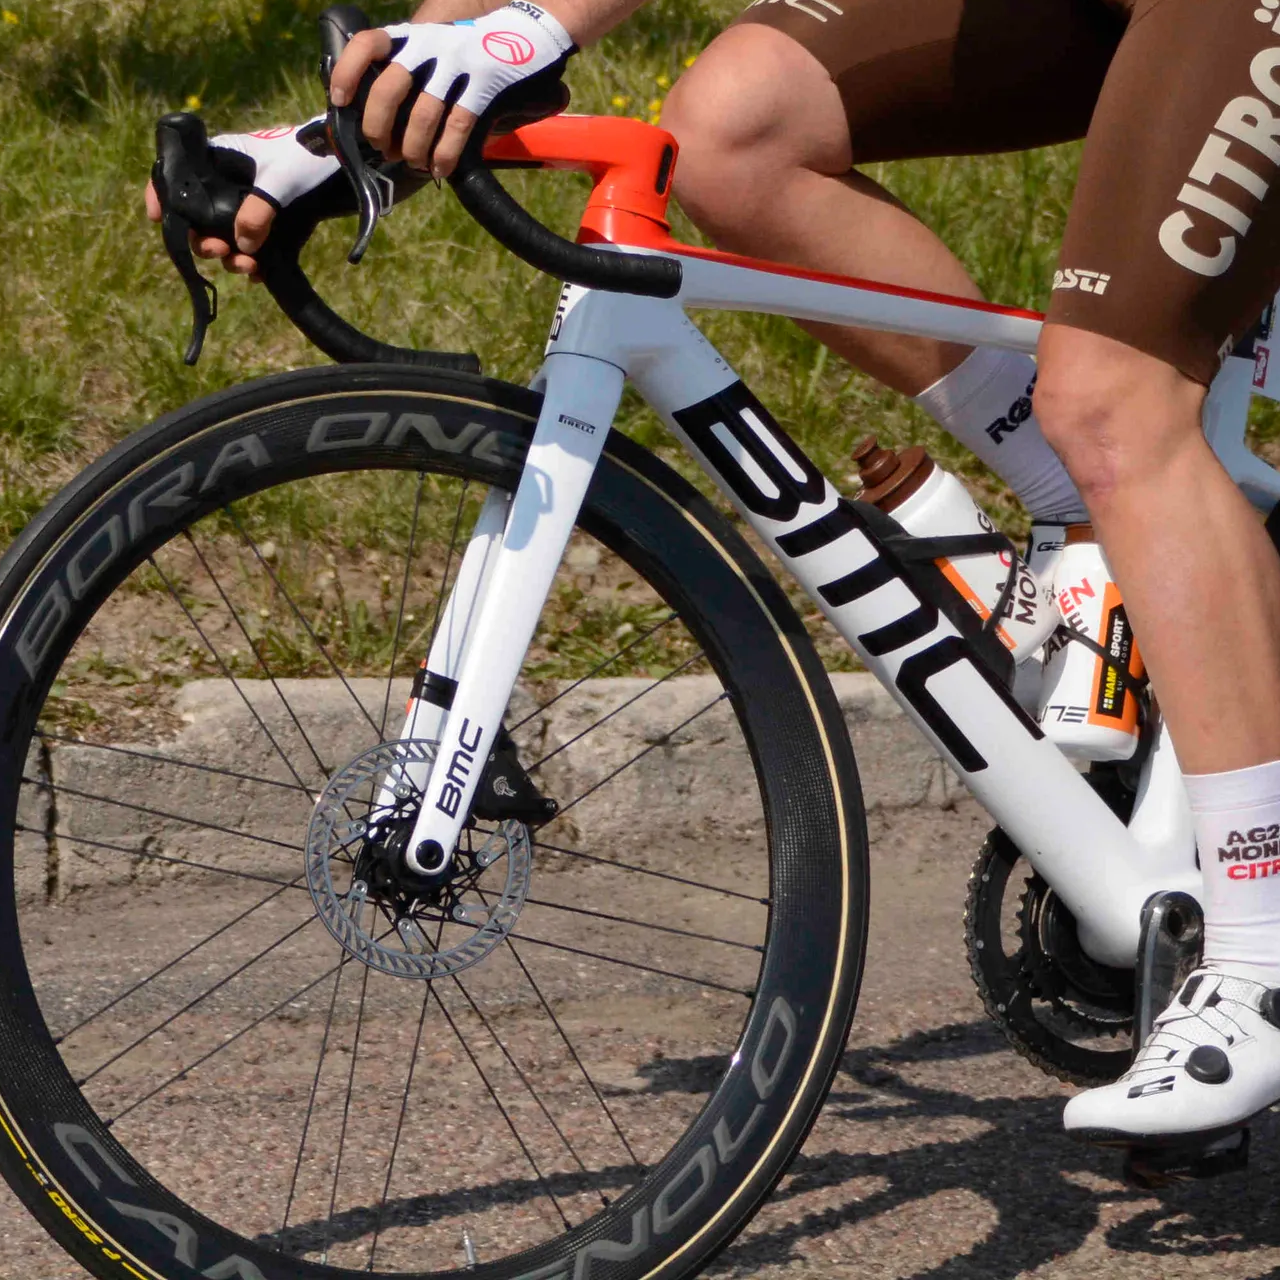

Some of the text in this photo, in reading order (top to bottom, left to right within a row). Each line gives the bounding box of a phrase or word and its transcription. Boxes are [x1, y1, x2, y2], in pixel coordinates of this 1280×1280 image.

[558, 414, 596, 435] PIRELLI
[15, 432, 273, 683] BORA
[672, 379, 1046, 773] BMC
[1110, 618, 1124, 658] SPORT
[435, 717, 483, 820] BMC
[47, 1190, 104, 1246] ZERO
